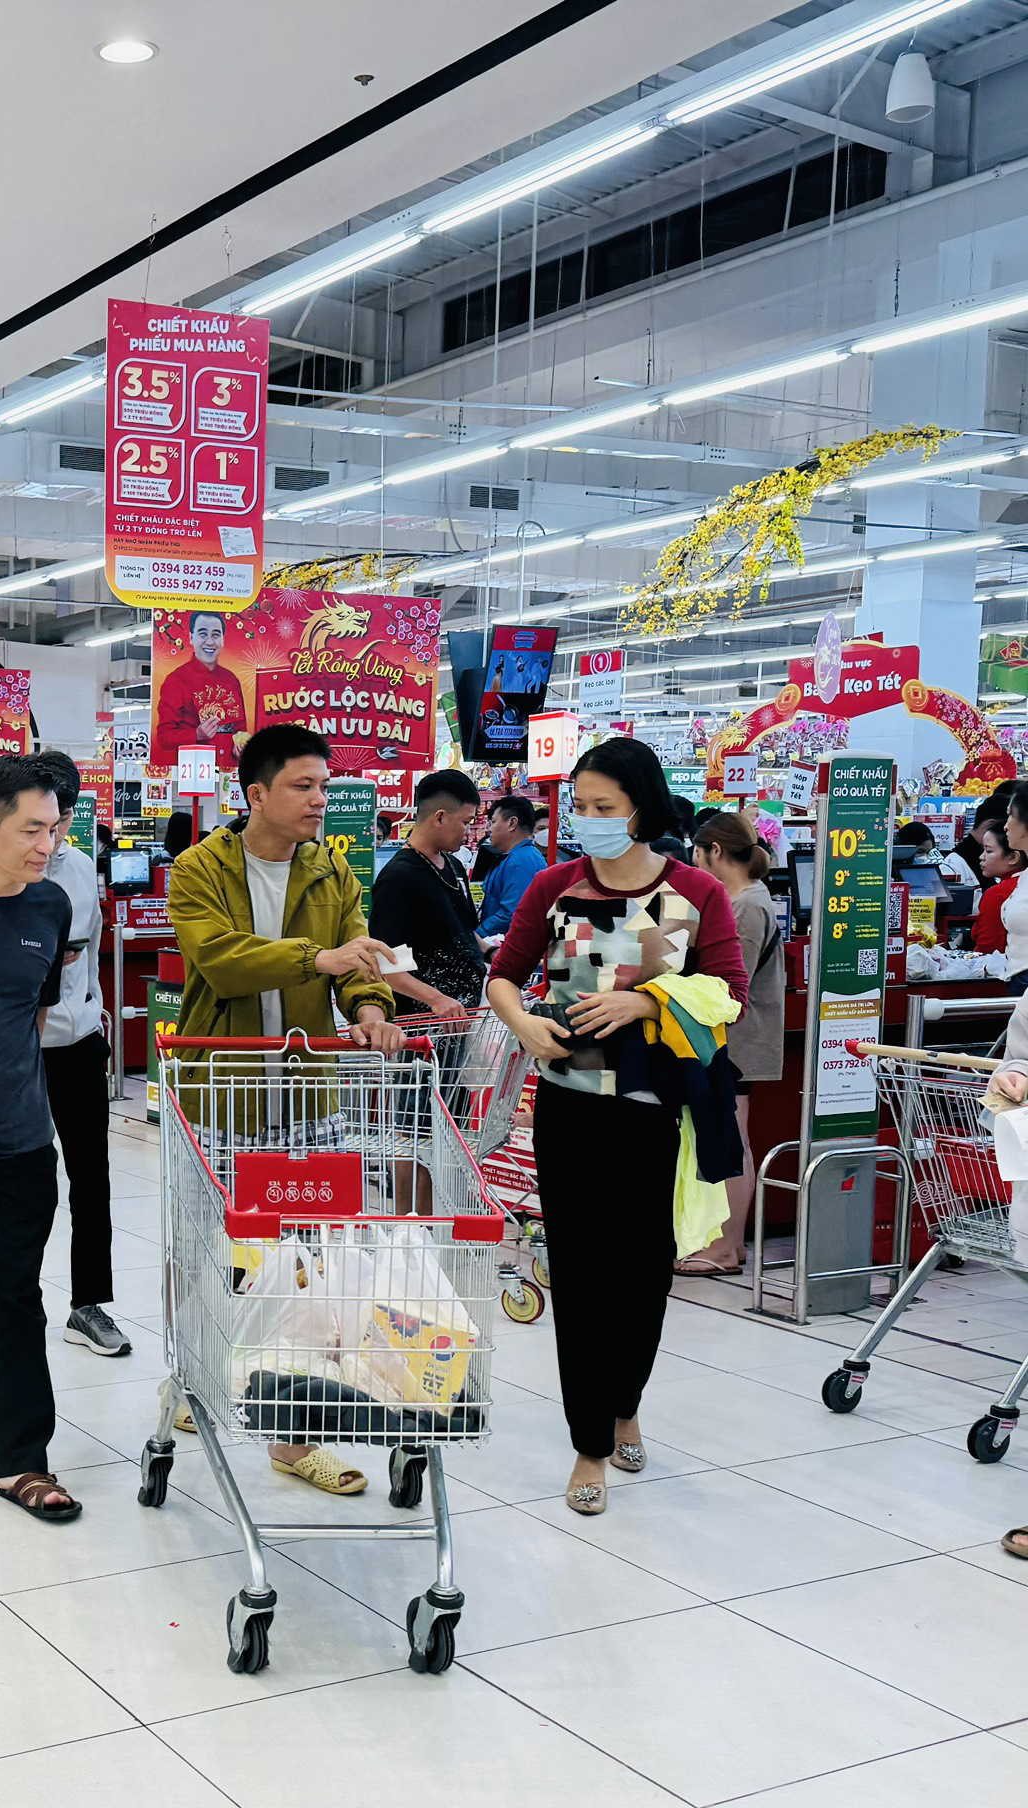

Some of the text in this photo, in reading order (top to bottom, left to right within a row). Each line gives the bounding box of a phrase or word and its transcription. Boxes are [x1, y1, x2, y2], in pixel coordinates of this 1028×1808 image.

[147, 314, 231, 335] CHIẾT KHẤU
[129, 333, 247, 354] PHIẾU MUA HÀNG
[122, 365, 182, 401] 3.5%
[211, 375, 244, 408] 3%
[121, 442, 180, 476] 2.5%
[215, 452, 240, 481] 1%
[116, 512, 140, 523] CHIẾT
[141, 514, 163, 526] KHẤU
[151, 562, 180, 574] 0394
[183, 564, 203, 576] 823
[204, 565, 226, 577] 459
[151, 577, 180, 589] 0935
[182, 579, 202, 591] 947
[205, 580, 224, 592] 792
[290, 650, 404, 687] Tết Rồng Vàng
[855, 658, 873, 671] vực
[843, 671, 902, 699] Kẹo Tết
[263, 685, 426, 718] RƯỚC LỘC VÀNG
[341, 717, 412, 743] ƯU ĐÃI
[535, 737, 555, 758] 19
[89, 773, 112, 784] HƠN
[181, 763, 192, 780] 21
[199, 763, 212, 779] 21
[727, 767, 745, 782] 22
[834, 765, 888, 781] CHIẾT KHẤU
[326, 788, 372, 801] CHIẾT KHẤU
[832, 782, 888, 799] GIỎ QUÀ TẾT
[142, 807, 159, 816] 129
[358, 802, 372, 813] TẾT
[325, 833, 357, 856] 10%
[829, 829, 867, 859] 10%
[834, 869, 851, 887] 9%
[832, 922, 848, 940] 8%
[821, 1039, 843, 1049] 0394
[822, 1059, 861, 1070] 0373 792
